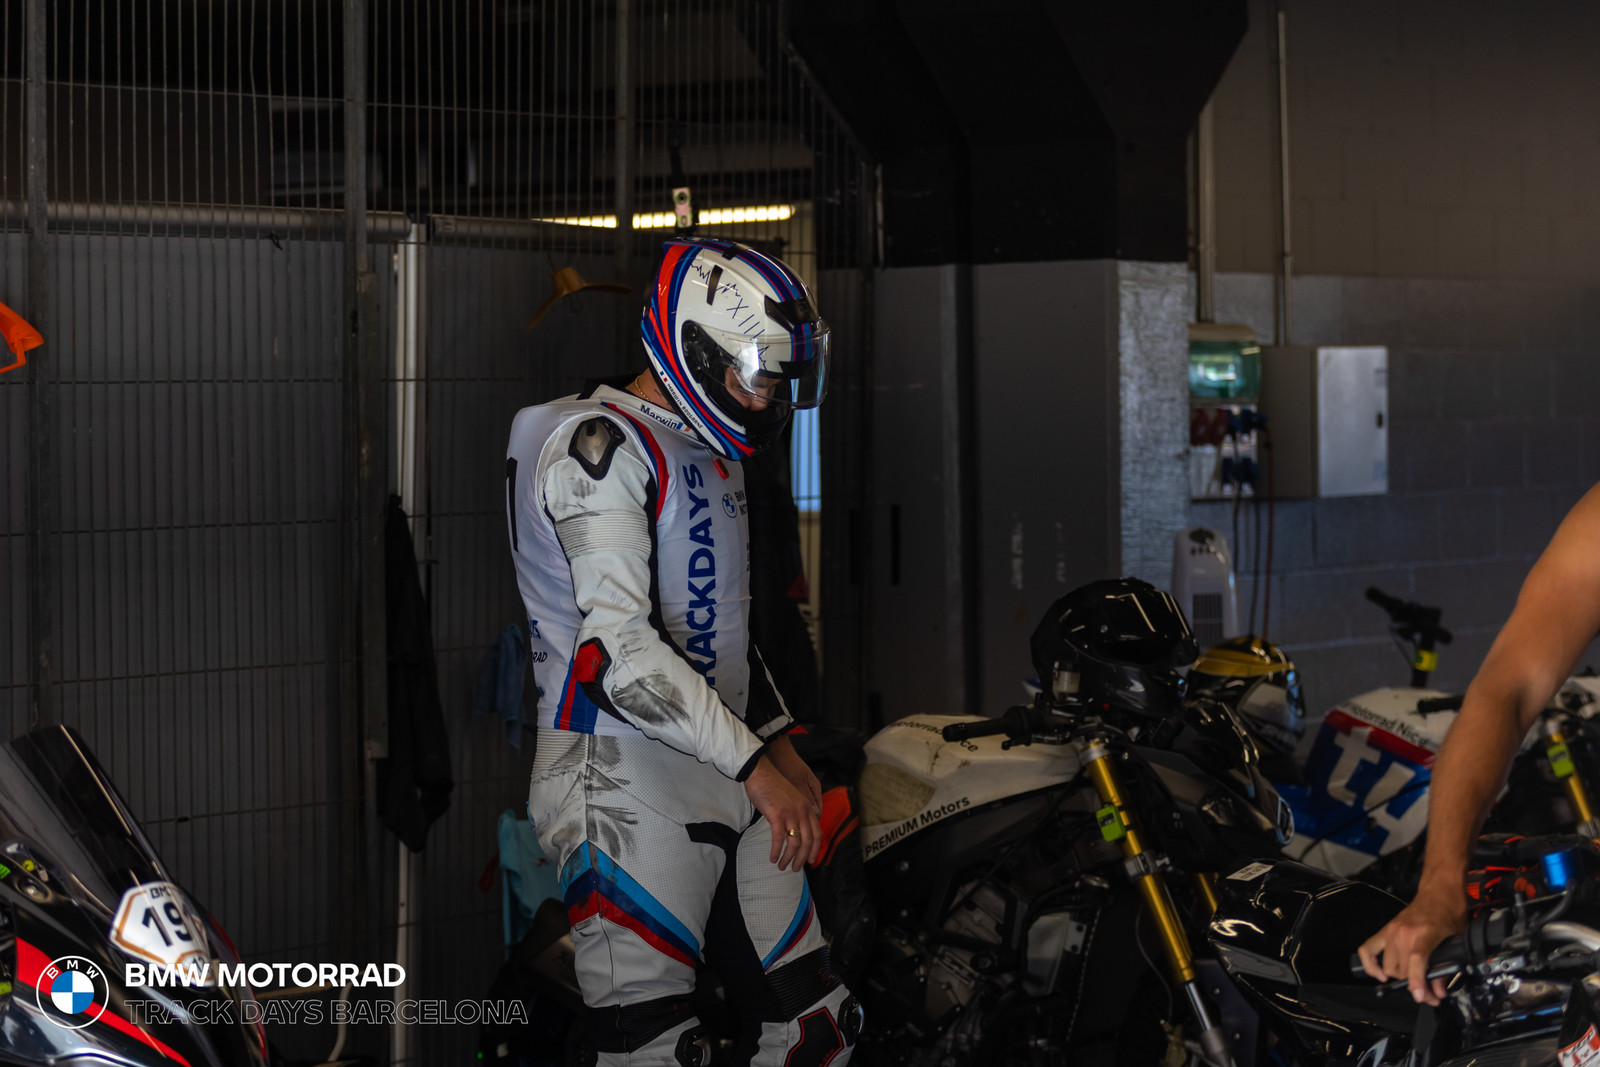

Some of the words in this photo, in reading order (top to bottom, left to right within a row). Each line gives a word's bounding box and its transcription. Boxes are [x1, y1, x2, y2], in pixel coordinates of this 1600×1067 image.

[640, 404, 677, 429] Marwin
[531, 651, 548, 663] RAD
[864, 816, 919, 858] PREMIUM
[920, 796, 971, 826] Motors
